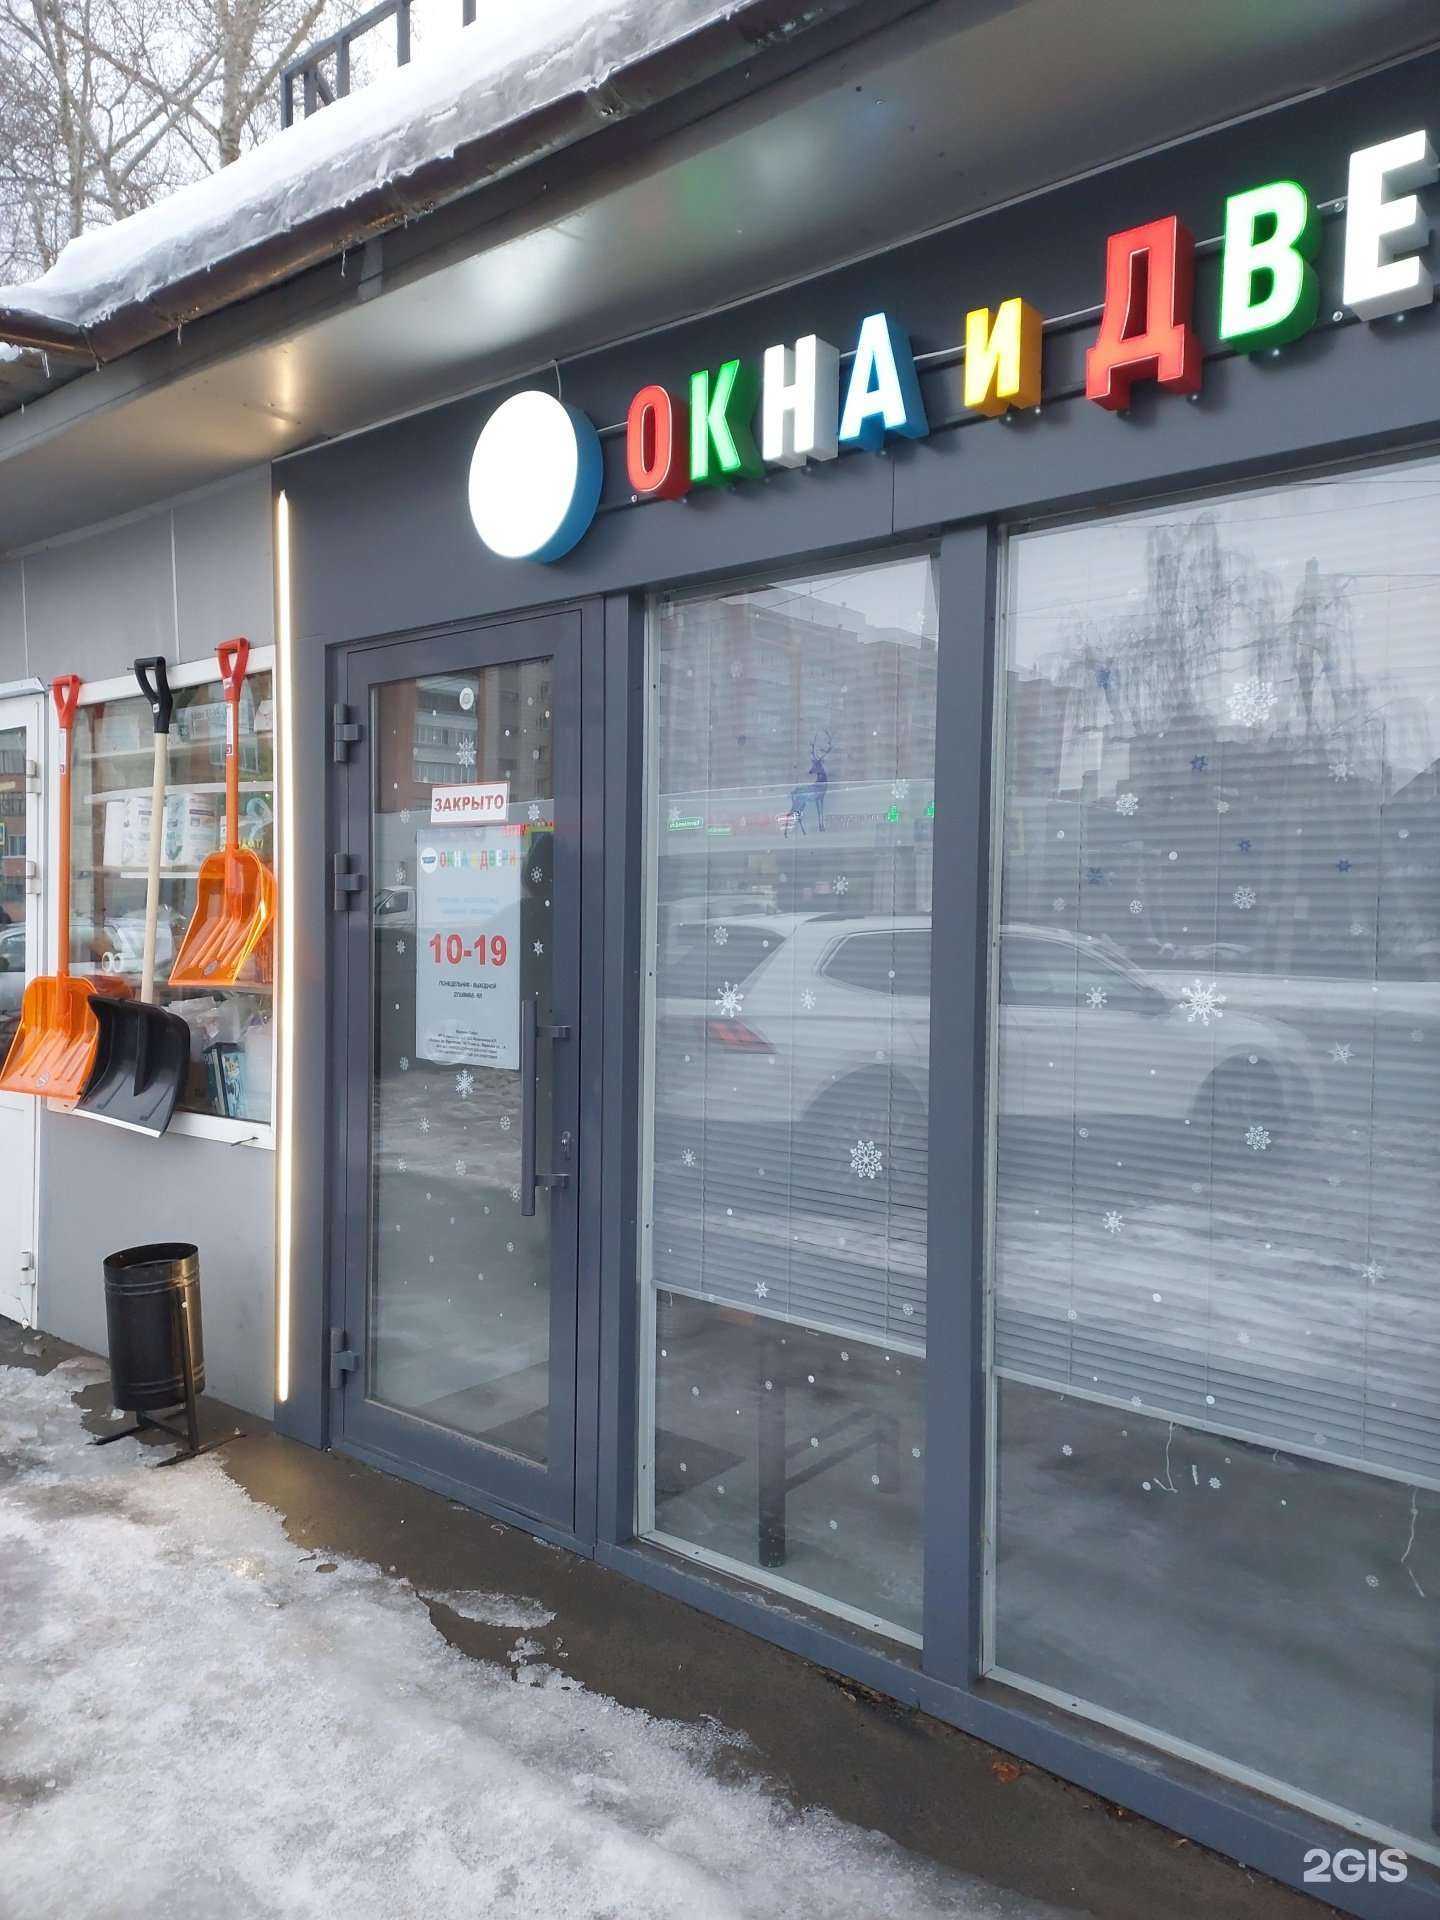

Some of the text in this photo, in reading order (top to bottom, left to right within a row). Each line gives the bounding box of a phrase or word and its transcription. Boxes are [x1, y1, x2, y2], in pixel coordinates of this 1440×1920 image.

[627, 313, 921, 495] ОКНА
[1086, 129, 1430, 404] ДВЕ
[434, 794, 505, 812] ЗАКРЫТО
[430, 933, 507, 966] 10-19
